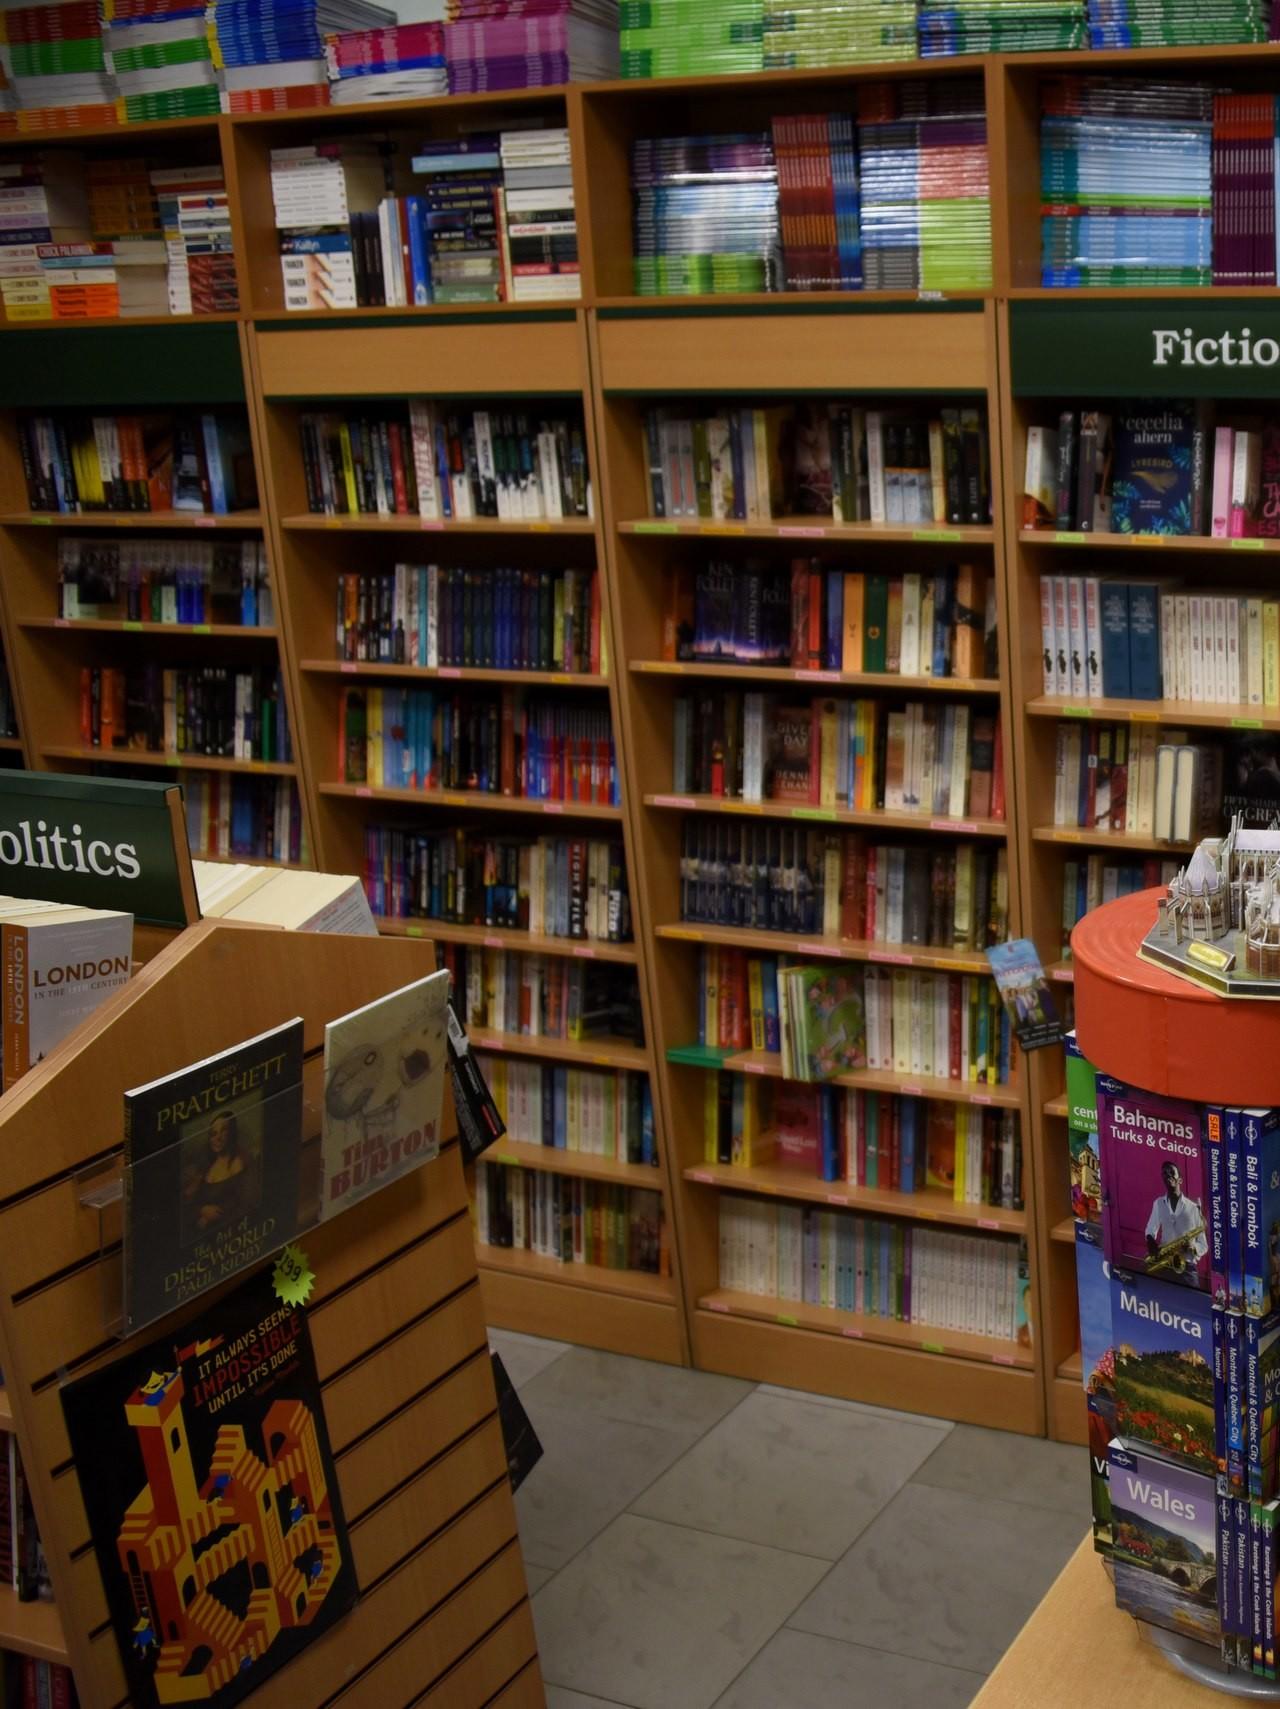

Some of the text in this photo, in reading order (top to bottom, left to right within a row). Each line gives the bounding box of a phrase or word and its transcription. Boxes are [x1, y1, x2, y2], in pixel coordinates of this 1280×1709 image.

[1126, 411, 1184, 430] cecelia
[1134, 430, 1173, 444] ahern
[0, 820, 141, 879] olitics
[572, 845, 581, 934] NIGHT FILM
[14, 936, 25, 1025] LONDON
[34, 956, 129, 988] LONDON
[35, 976, 128, 999] IN THE CENTURY
[156, 1052, 288, 1132] PRATCHETT
[1110, 1125, 1198, 1158] Turks & Caicos
[1113, 1105, 1194, 1140] Bahamas
[1208, 1115, 1221, 1142] SALE
[330, 1119, 437, 1201] BURTON
[1270, 1171, 1280, 1189] &
[1228, 1152, 1239, 1229] Baja & Los Cabos
[1246, 1155, 1259, 1249] Bali & Lombok
[1212, 1195, 1224, 1260] Turks & Caicos
[164, 1217, 277, 1293] DISCWORLD
[1120, 1290, 1202, 1339] Mallorca
[191, 1311, 302, 1408] IMPOSSIBLE
[198, 1306, 293, 1380] IT ALWAYS SEEMS
[208, 1382, 246, 1415] UNTIL
[247, 1364, 270, 1387] IT'S
[270, 1339, 299, 1370] DONE
[1230, 1385, 1238, 1393] &
[1264, 1390, 1274, 1403] &
[1248, 1354, 1259, 1463] Montréal & Québec City
[1230, 1428, 1239, 1442] City
[1127, 1477, 1196, 1520] Wales
[1237, 1532, 1245, 1569] Pakistan
